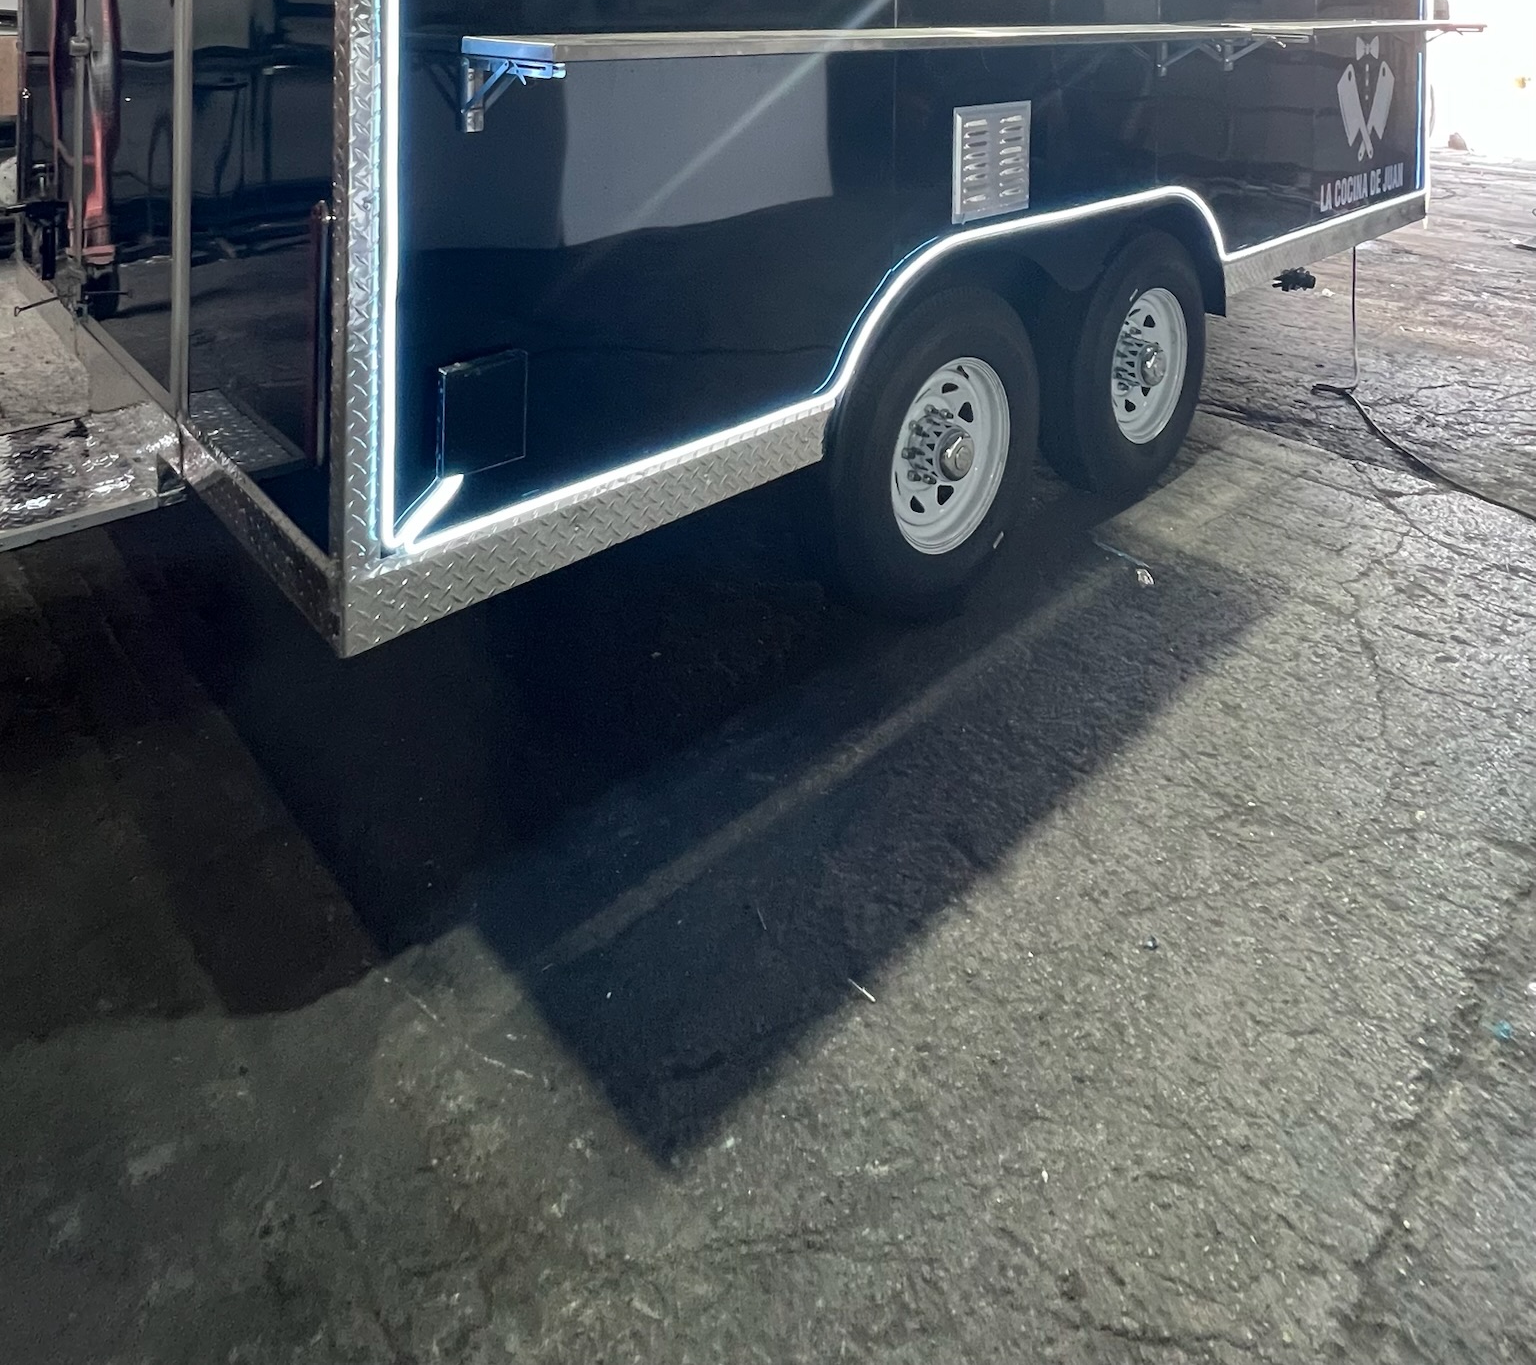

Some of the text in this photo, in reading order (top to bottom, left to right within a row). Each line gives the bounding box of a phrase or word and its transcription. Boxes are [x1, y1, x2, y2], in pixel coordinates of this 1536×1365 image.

[1320, 162, 1404, 212] LA COCINA DE JUAN
